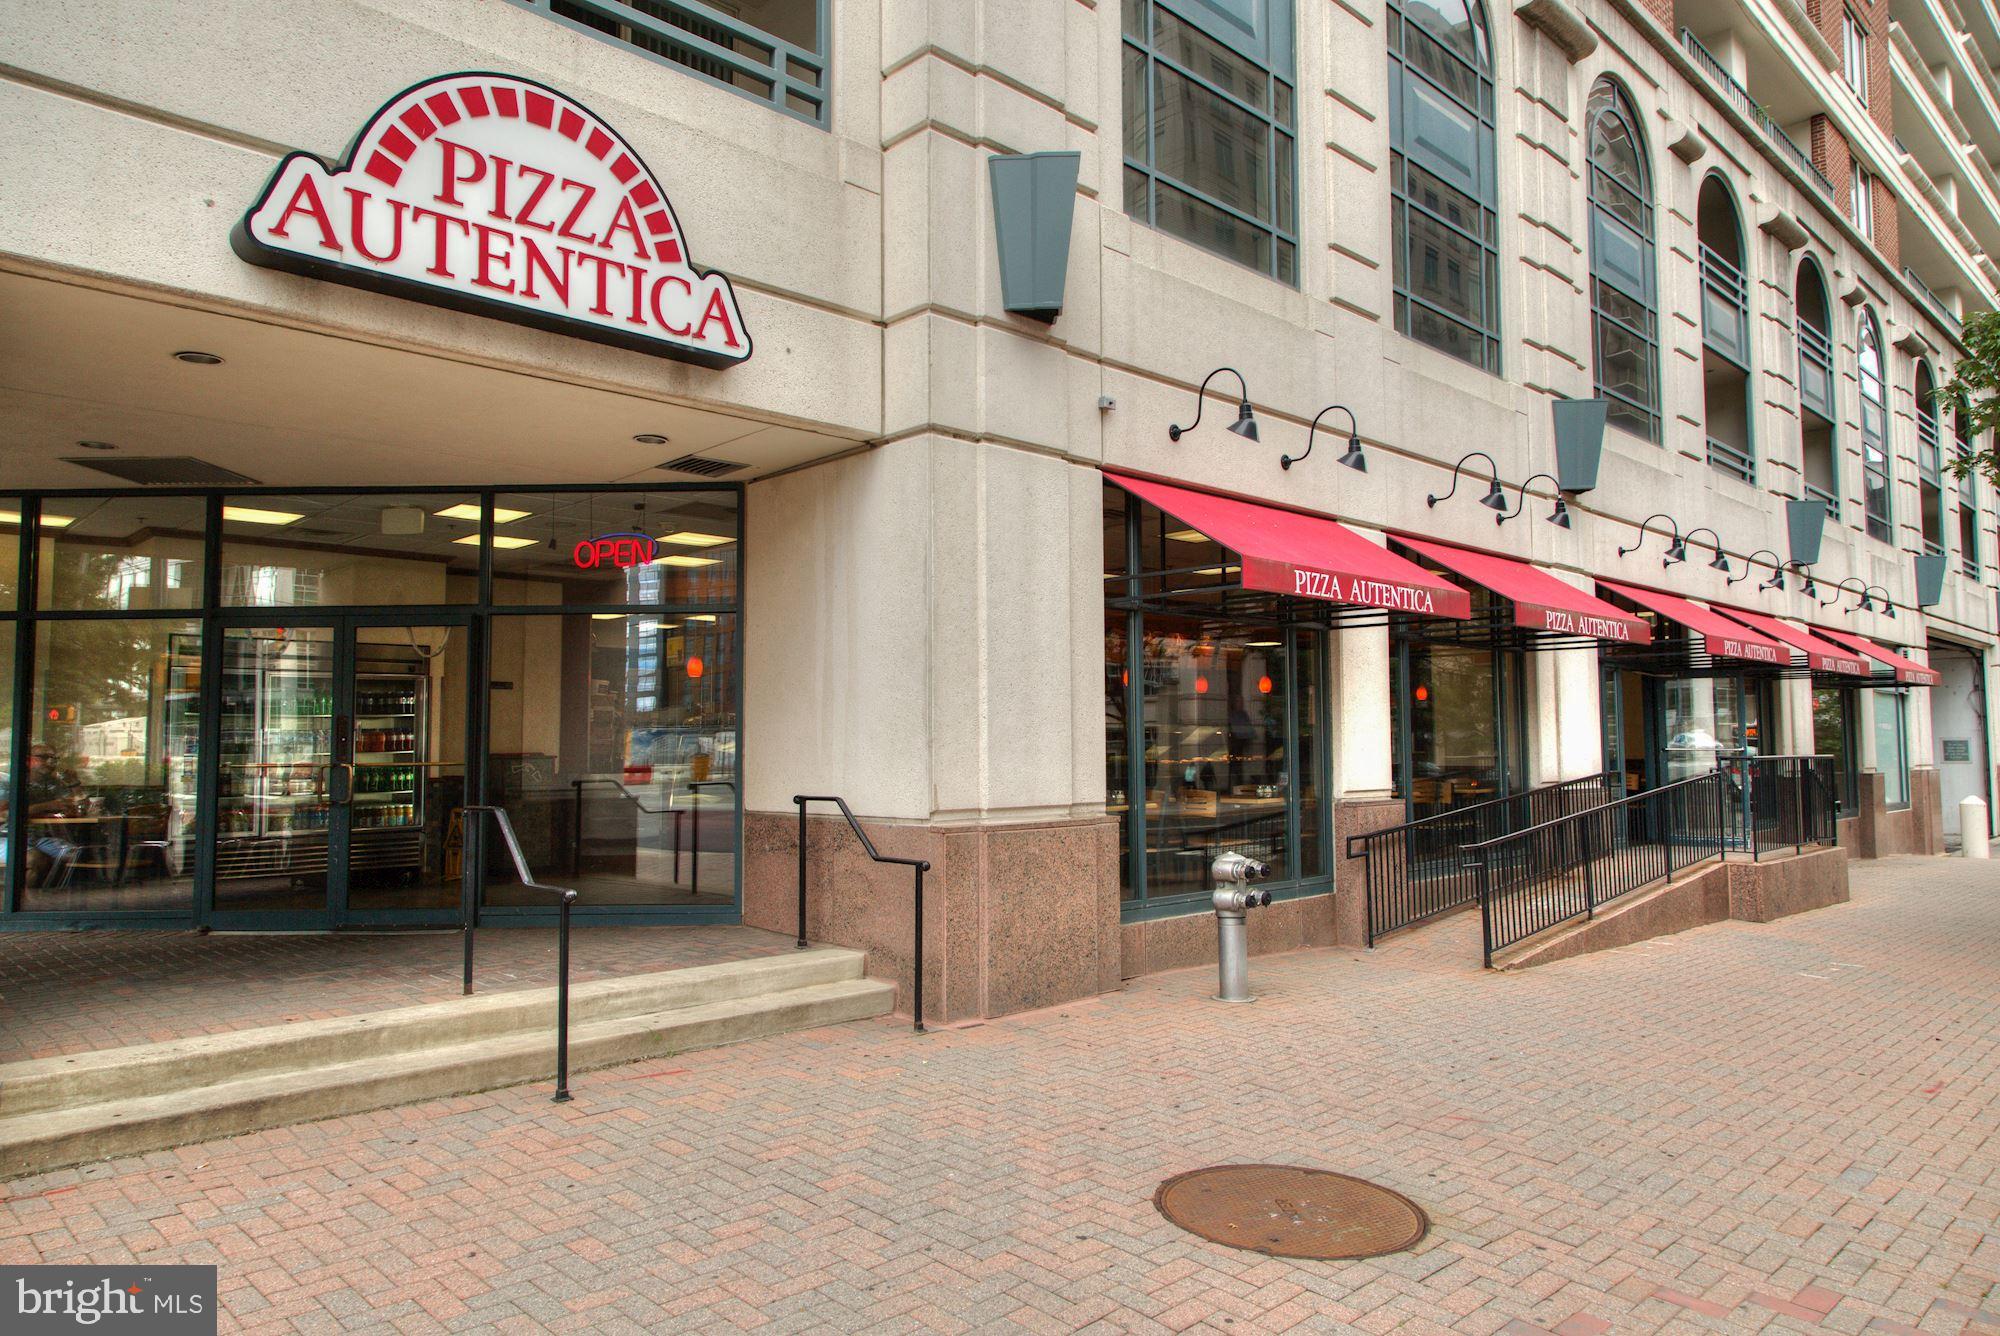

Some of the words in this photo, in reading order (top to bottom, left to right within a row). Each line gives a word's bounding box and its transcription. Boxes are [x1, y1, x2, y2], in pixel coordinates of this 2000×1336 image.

[433, 137, 651, 261] PIZZA
[268, 173, 741, 349] AUTENTICA
[573, 539, 653, 569] OPEN
[1294, 569, 1343, 600] PIZZA
[1350, 579, 1434, 613] AUTENTICA
[1545, 610, 1574, 632] PIZZA
[1578, 616, 1629, 641] AUTENTICA
[1723, 640, 1742, 657] PIZZA
[1744, 643, 1777, 662] AUTENTICA
